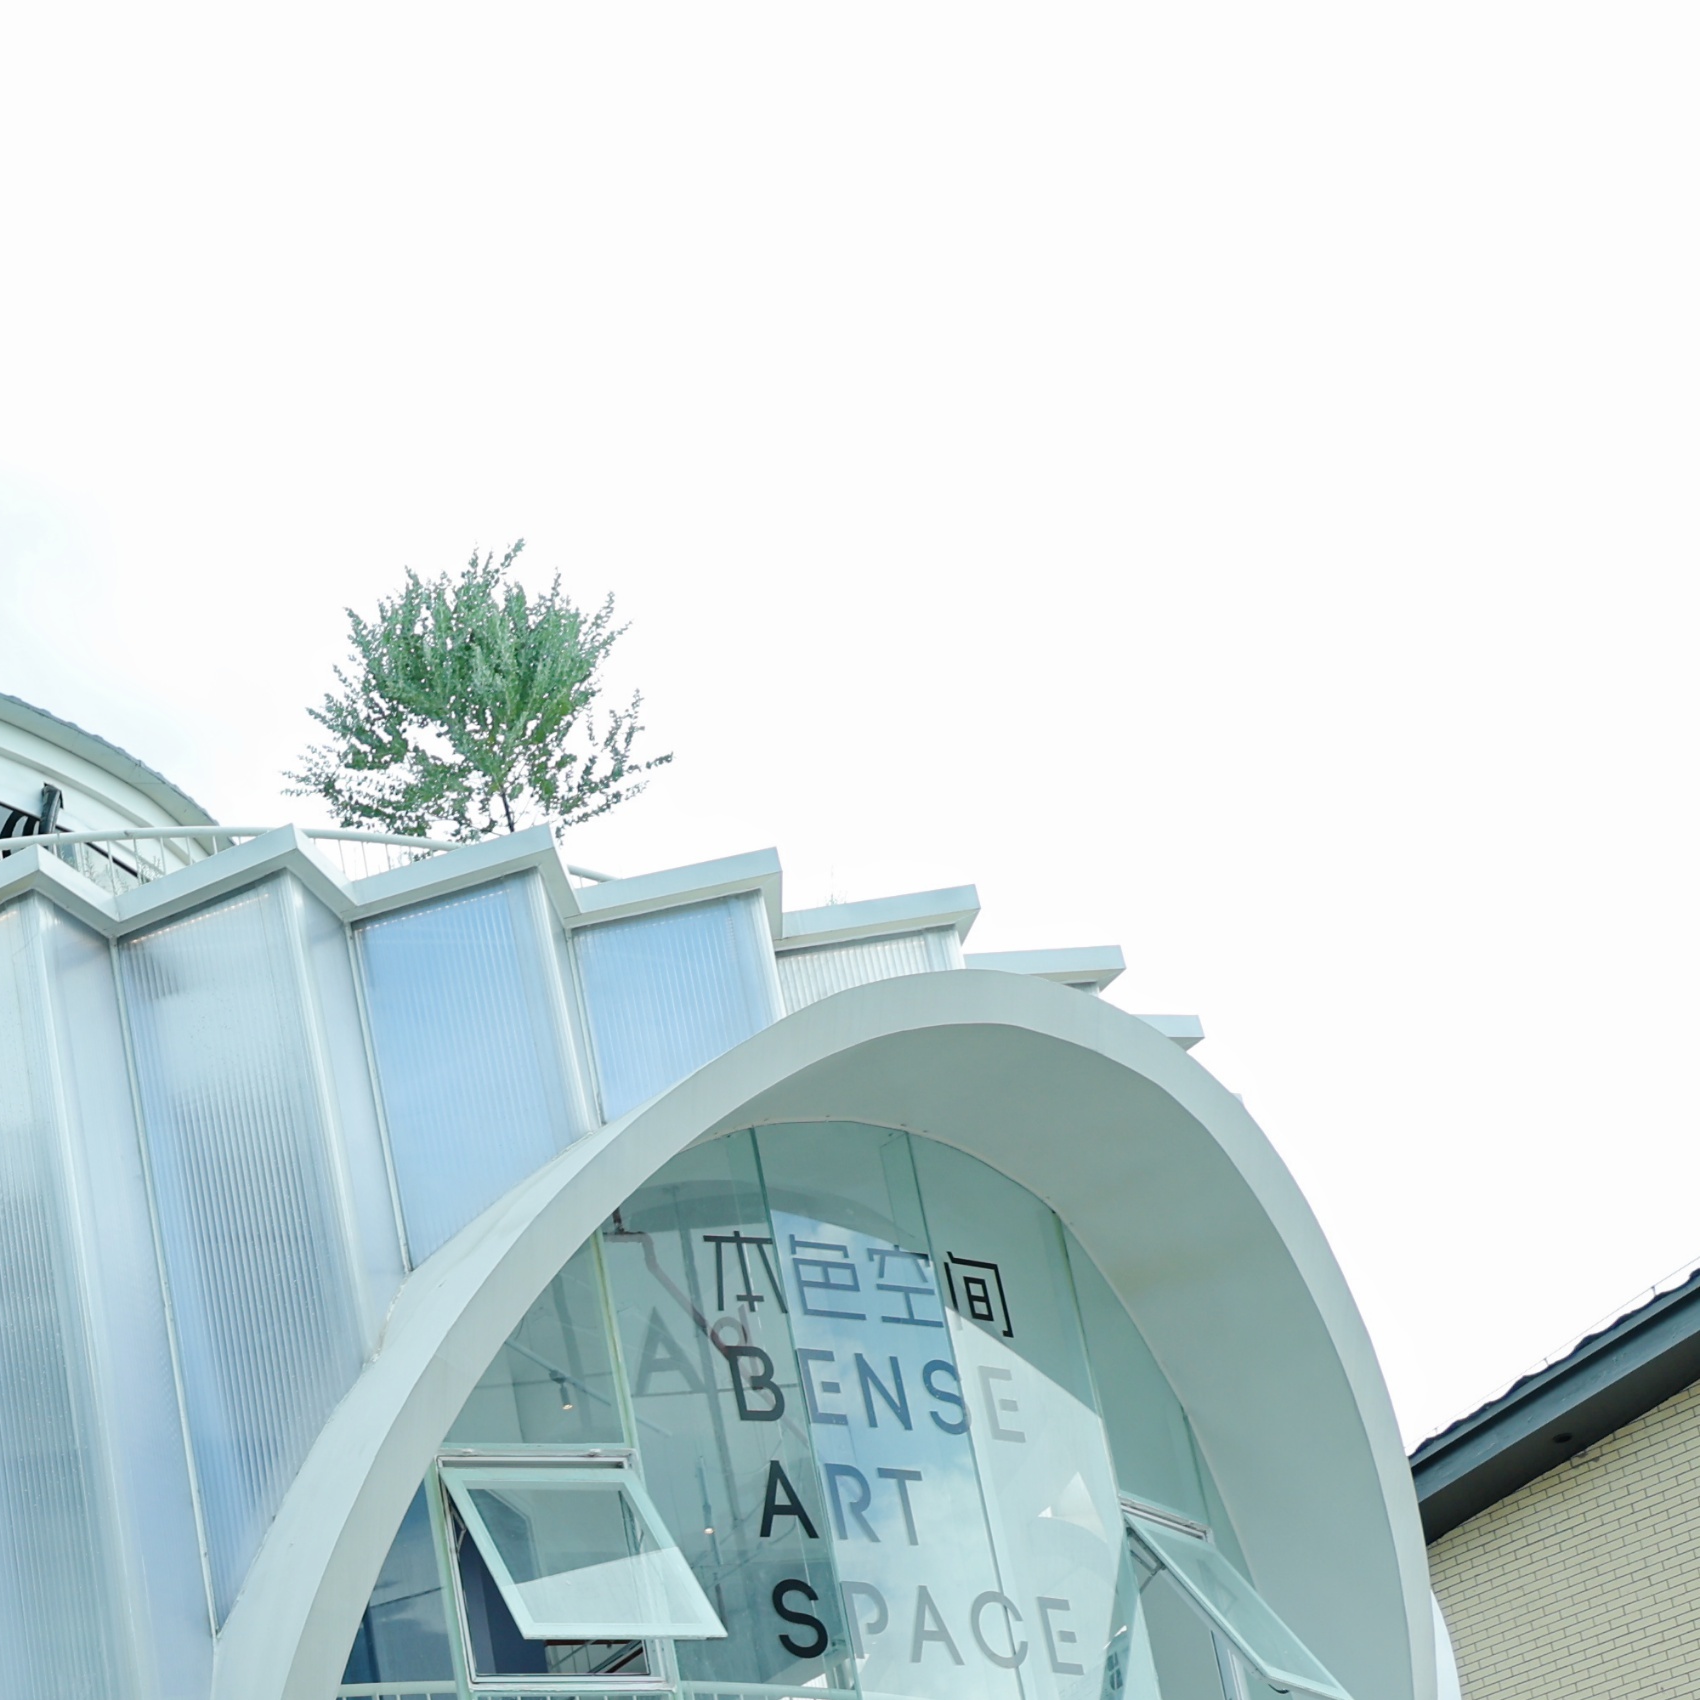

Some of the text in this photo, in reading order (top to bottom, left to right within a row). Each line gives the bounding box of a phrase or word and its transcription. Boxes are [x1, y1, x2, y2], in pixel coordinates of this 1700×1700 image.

[703, 1230, 1013, 1339] 本色空间
[727, 1345, 1027, 1445] BENSE
[760, 1460, 921, 1547] ART
[771, 1579, 1084, 1676] SPACE
